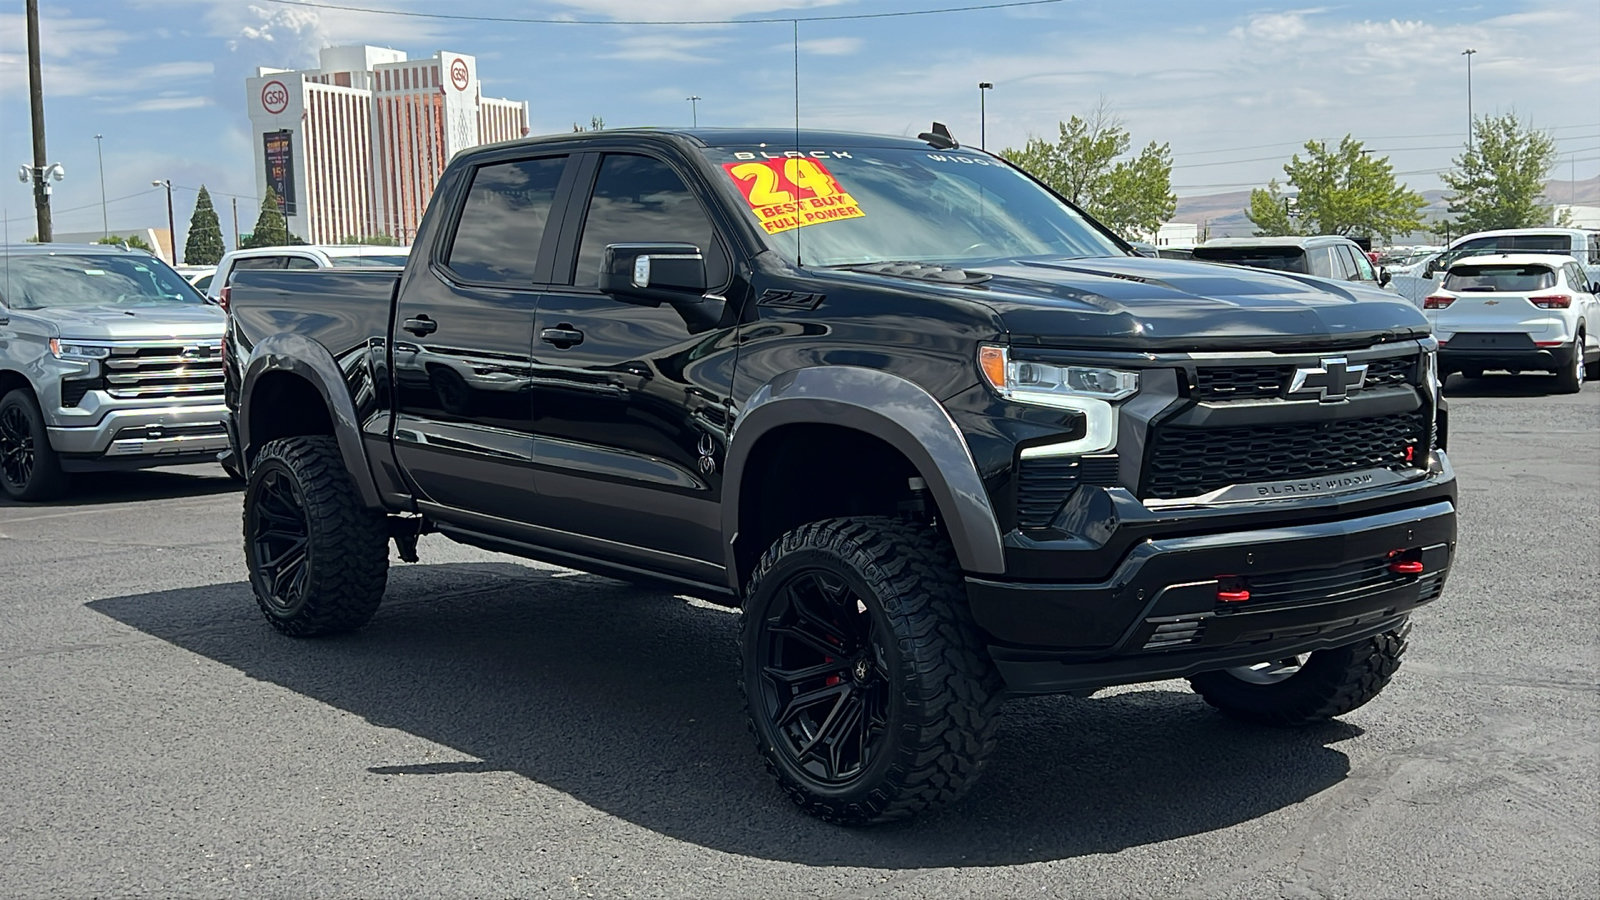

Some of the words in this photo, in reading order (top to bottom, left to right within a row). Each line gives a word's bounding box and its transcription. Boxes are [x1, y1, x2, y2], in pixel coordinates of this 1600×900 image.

[453, 67, 467, 82] GSR
[265, 90, 285, 105] GSR
[734, 150, 853, 160] BLACK
[730, 158, 839, 207] 24
[761, 201, 804, 218] BEST
[809, 195, 845, 208] BUY
[764, 216, 802, 232] FULL
[804, 206, 858, 222] POWER
[1257, 482, 1322, 496] BLACK
[1326, 474, 1373, 489] WIDOW
